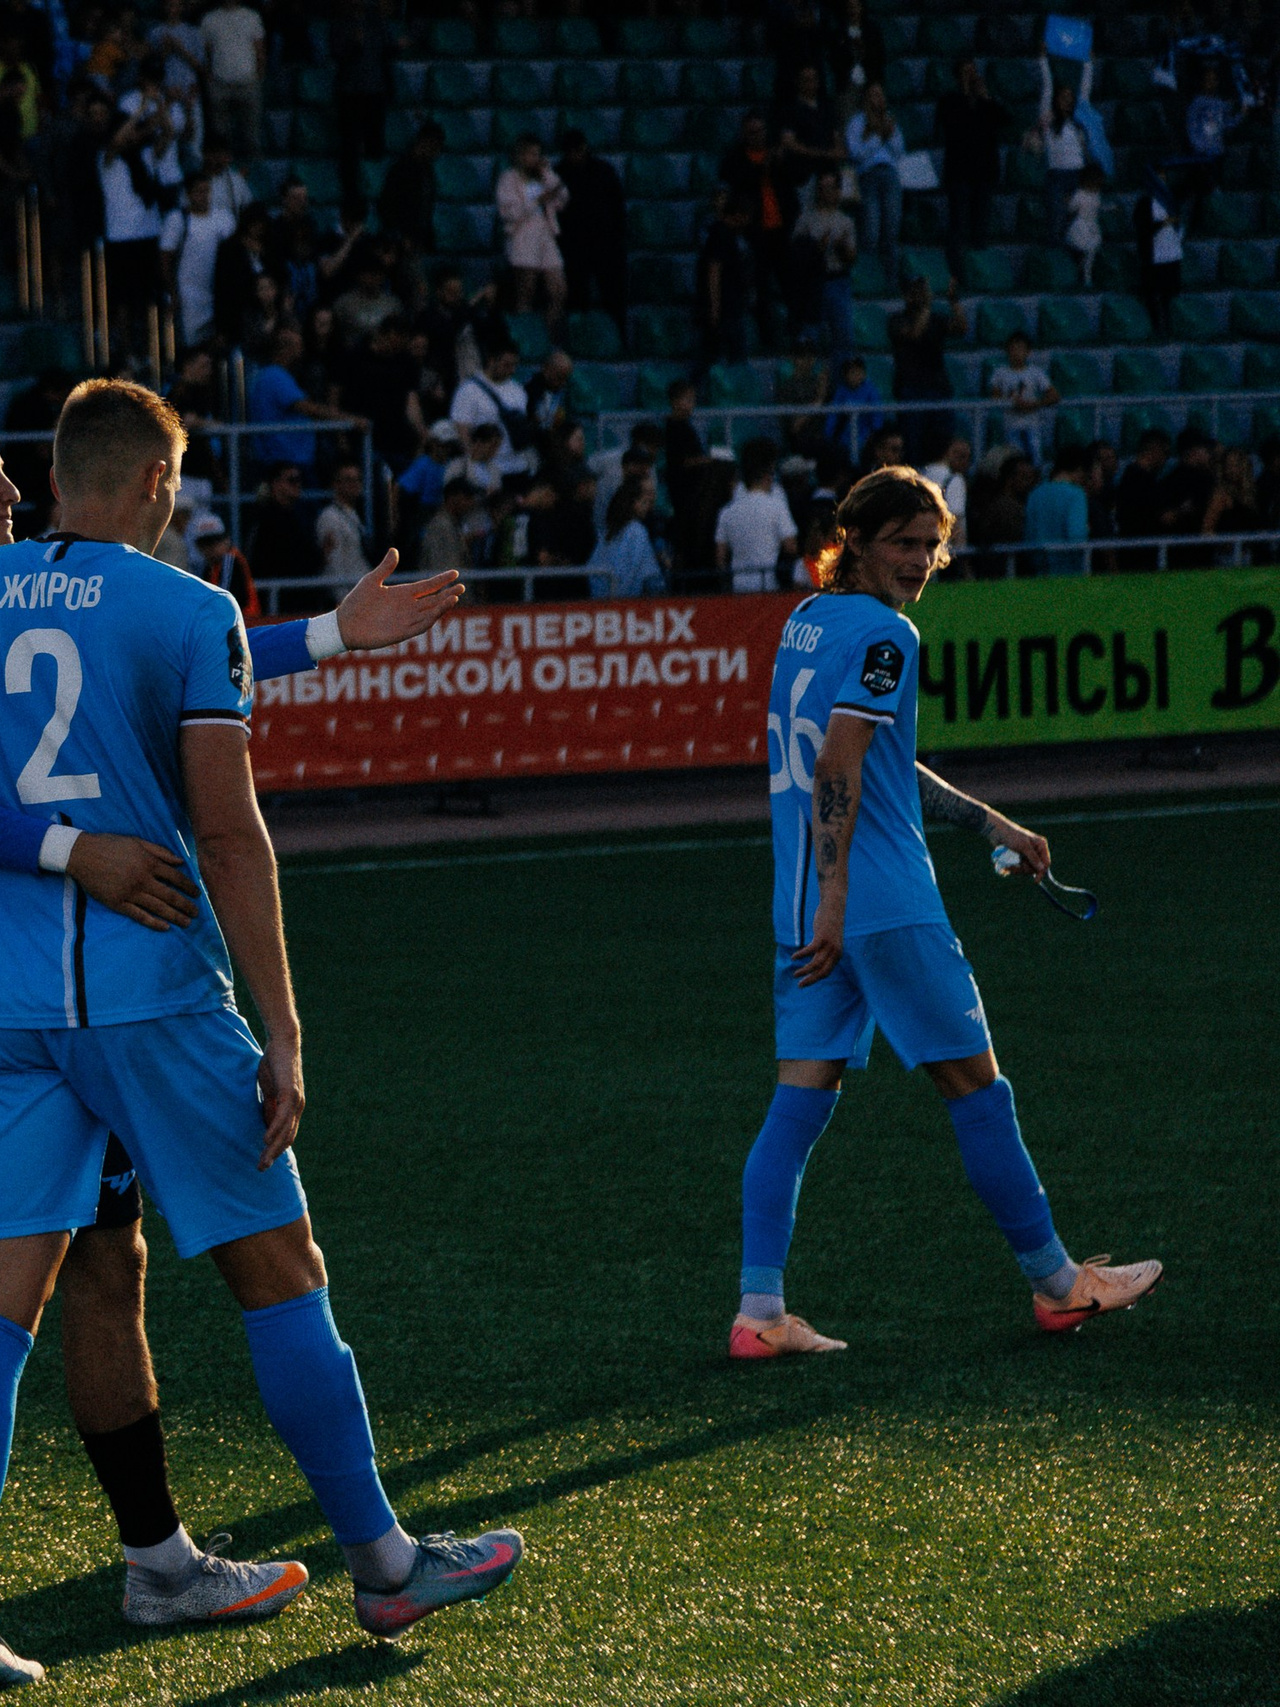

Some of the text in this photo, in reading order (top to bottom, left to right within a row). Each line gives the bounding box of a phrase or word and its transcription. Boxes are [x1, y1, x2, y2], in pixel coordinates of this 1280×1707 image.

[502, 608, 697, 653] ПЕРВЫХ
[249, 645, 522, 706] ЯБИНСКОЙ
[532, 647, 749, 692] ОБЛАСТИ
[919, 628, 1170, 723] ЧИПСЫ
[4, 628, 102, 805] 2
